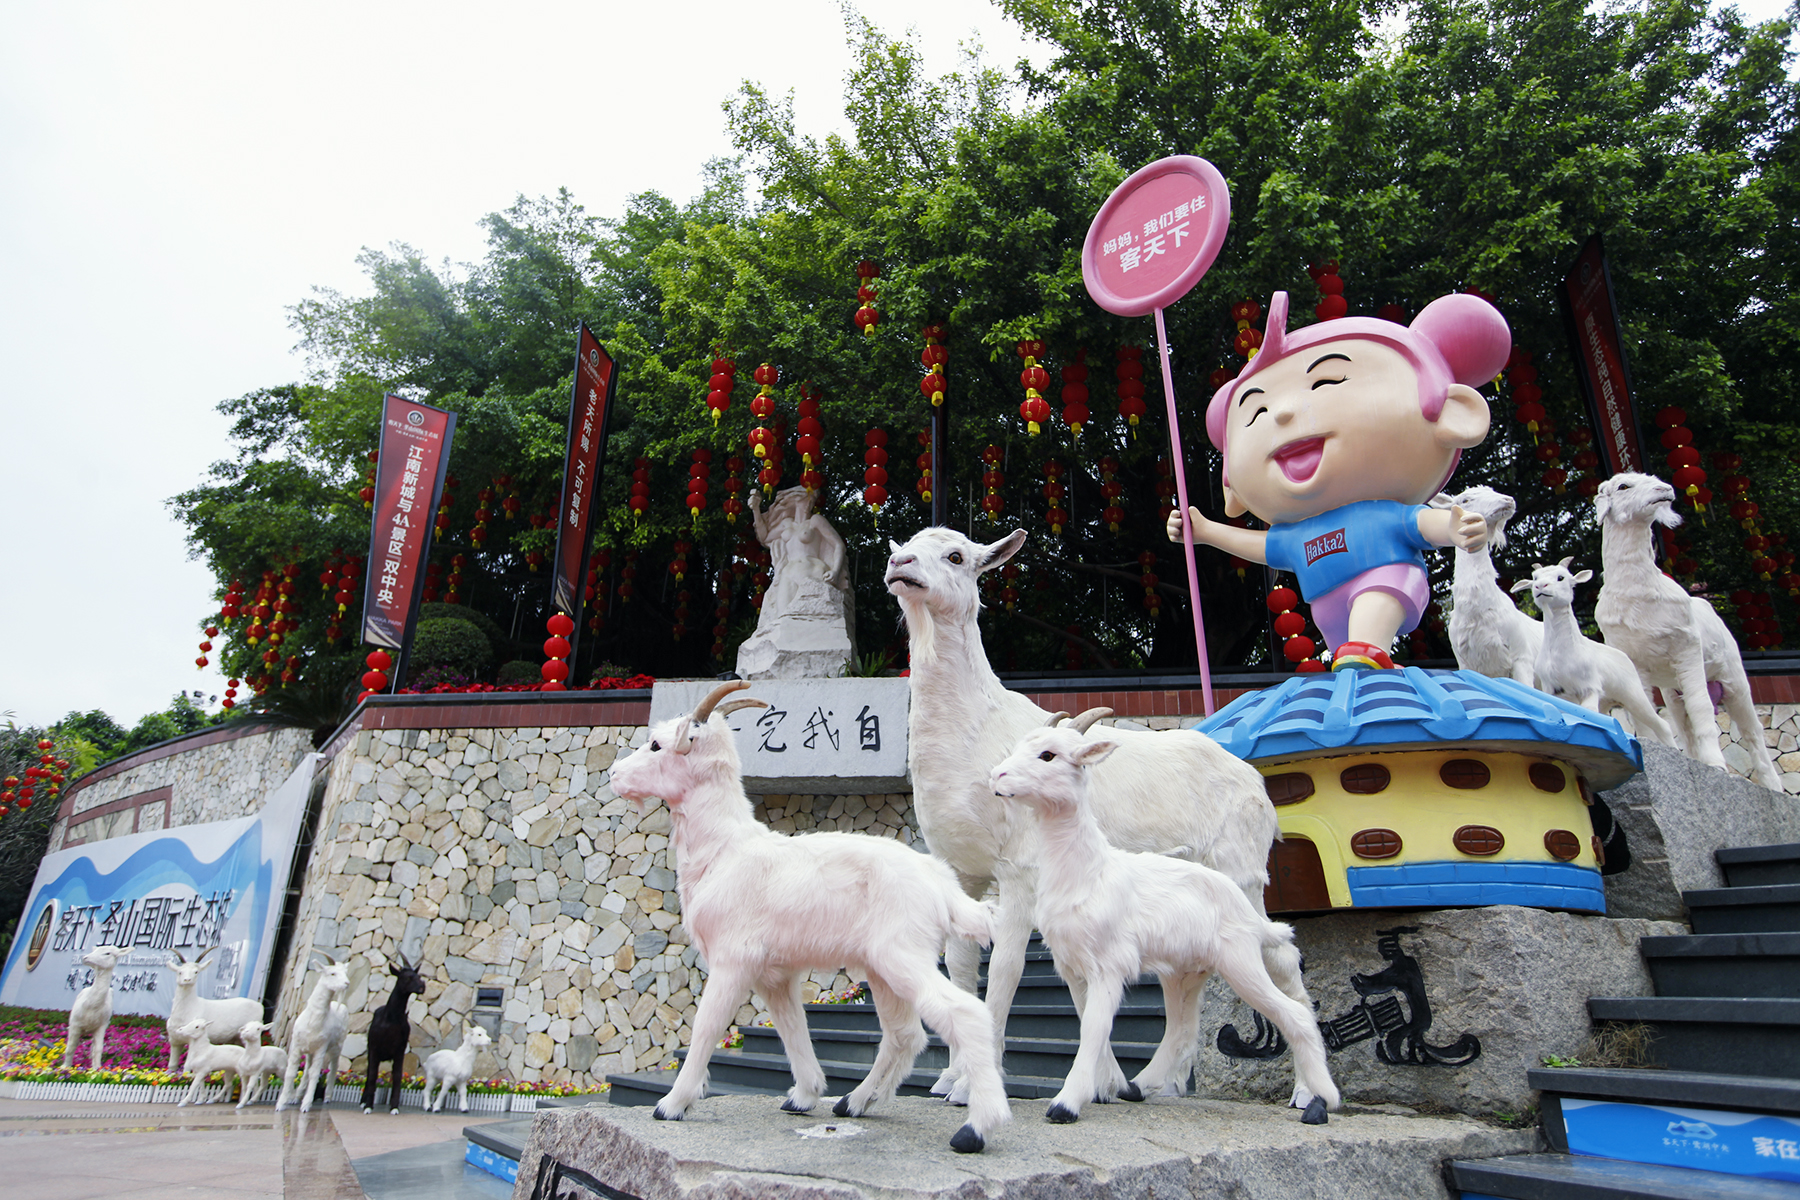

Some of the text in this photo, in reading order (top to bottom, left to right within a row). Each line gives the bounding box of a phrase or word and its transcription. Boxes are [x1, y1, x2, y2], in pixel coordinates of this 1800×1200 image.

[1102, 194, 1207, 257] 妈妈，我们要住
[1119, 221, 1190, 274] 客天下
[1306, 532, 1345, 562] Hakka2
[53, 904, 104, 951] 客天下
[1752, 1136, 1800, 1160] 家在
